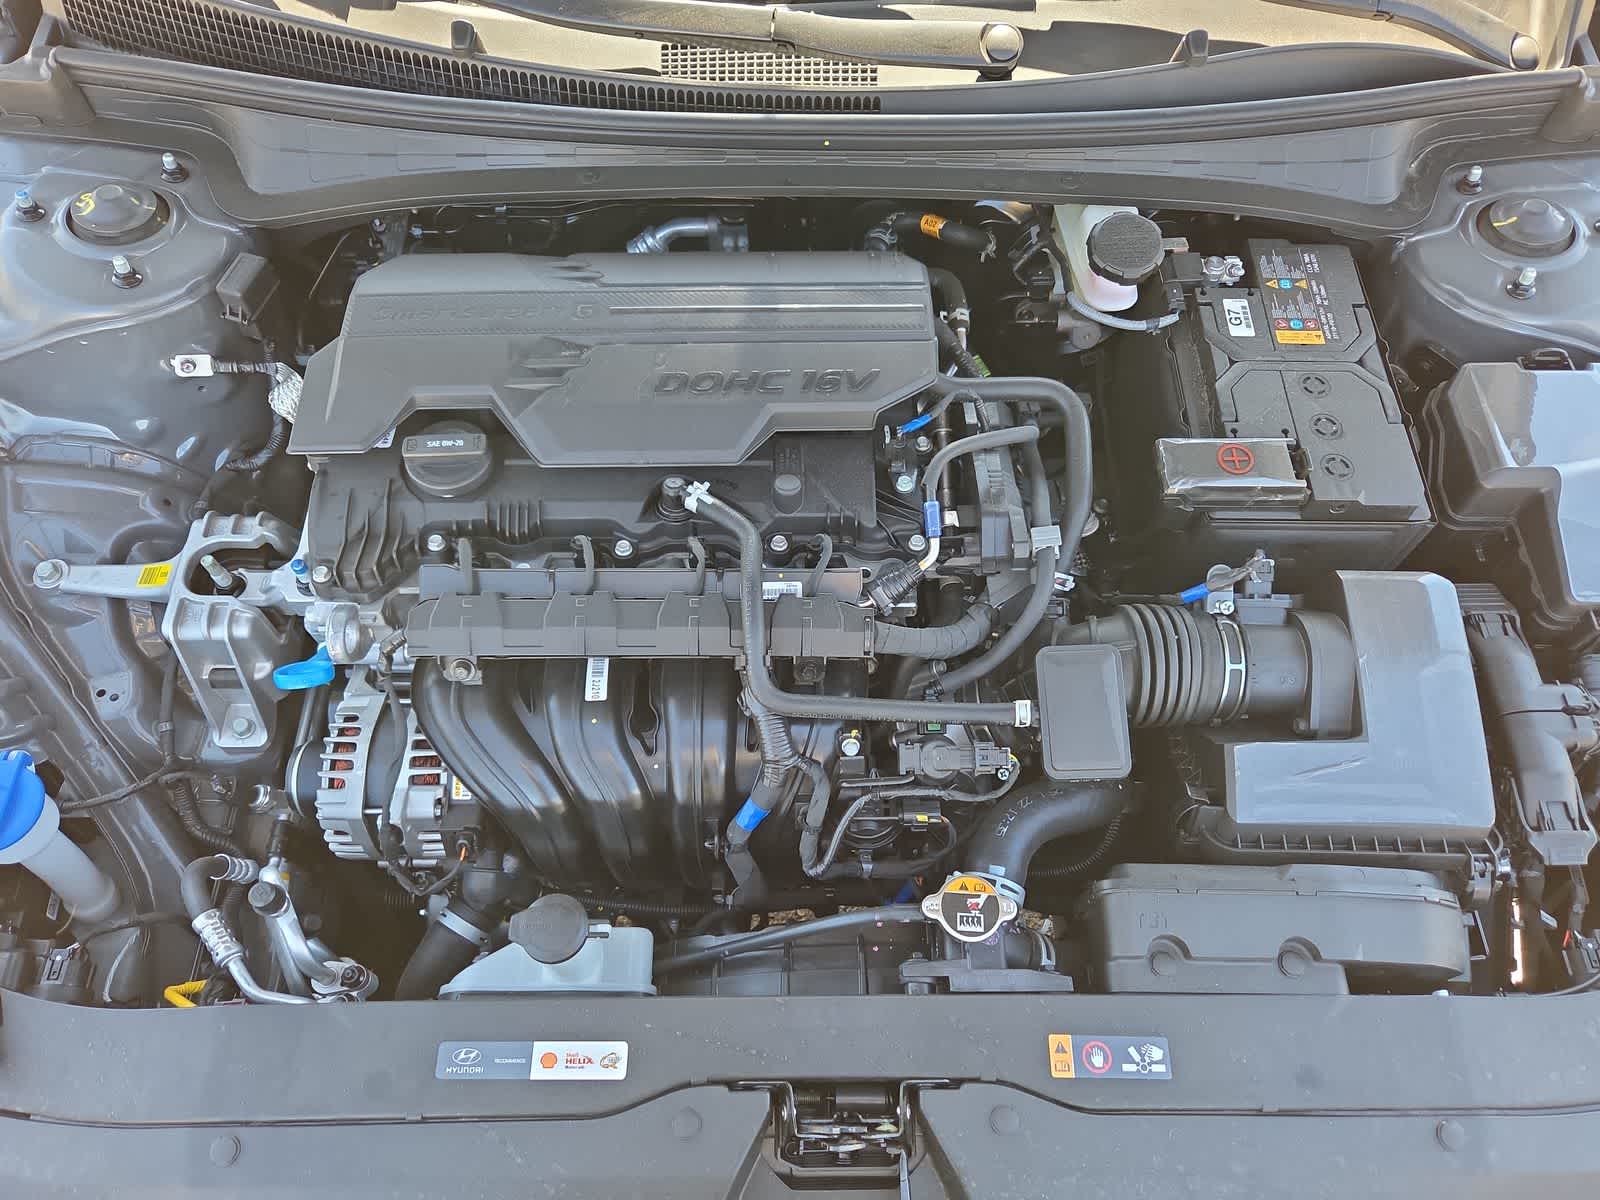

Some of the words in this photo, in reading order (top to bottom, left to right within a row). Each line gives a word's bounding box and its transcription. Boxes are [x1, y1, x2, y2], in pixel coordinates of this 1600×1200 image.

[1227, 308, 1243, 327] G7
[654, 368, 793, 394] DOHC
[800, 368, 881, 393] 16V
[426, 439, 441, 448] SAE
[446, 1066, 484, 1074] HYUNDAI
